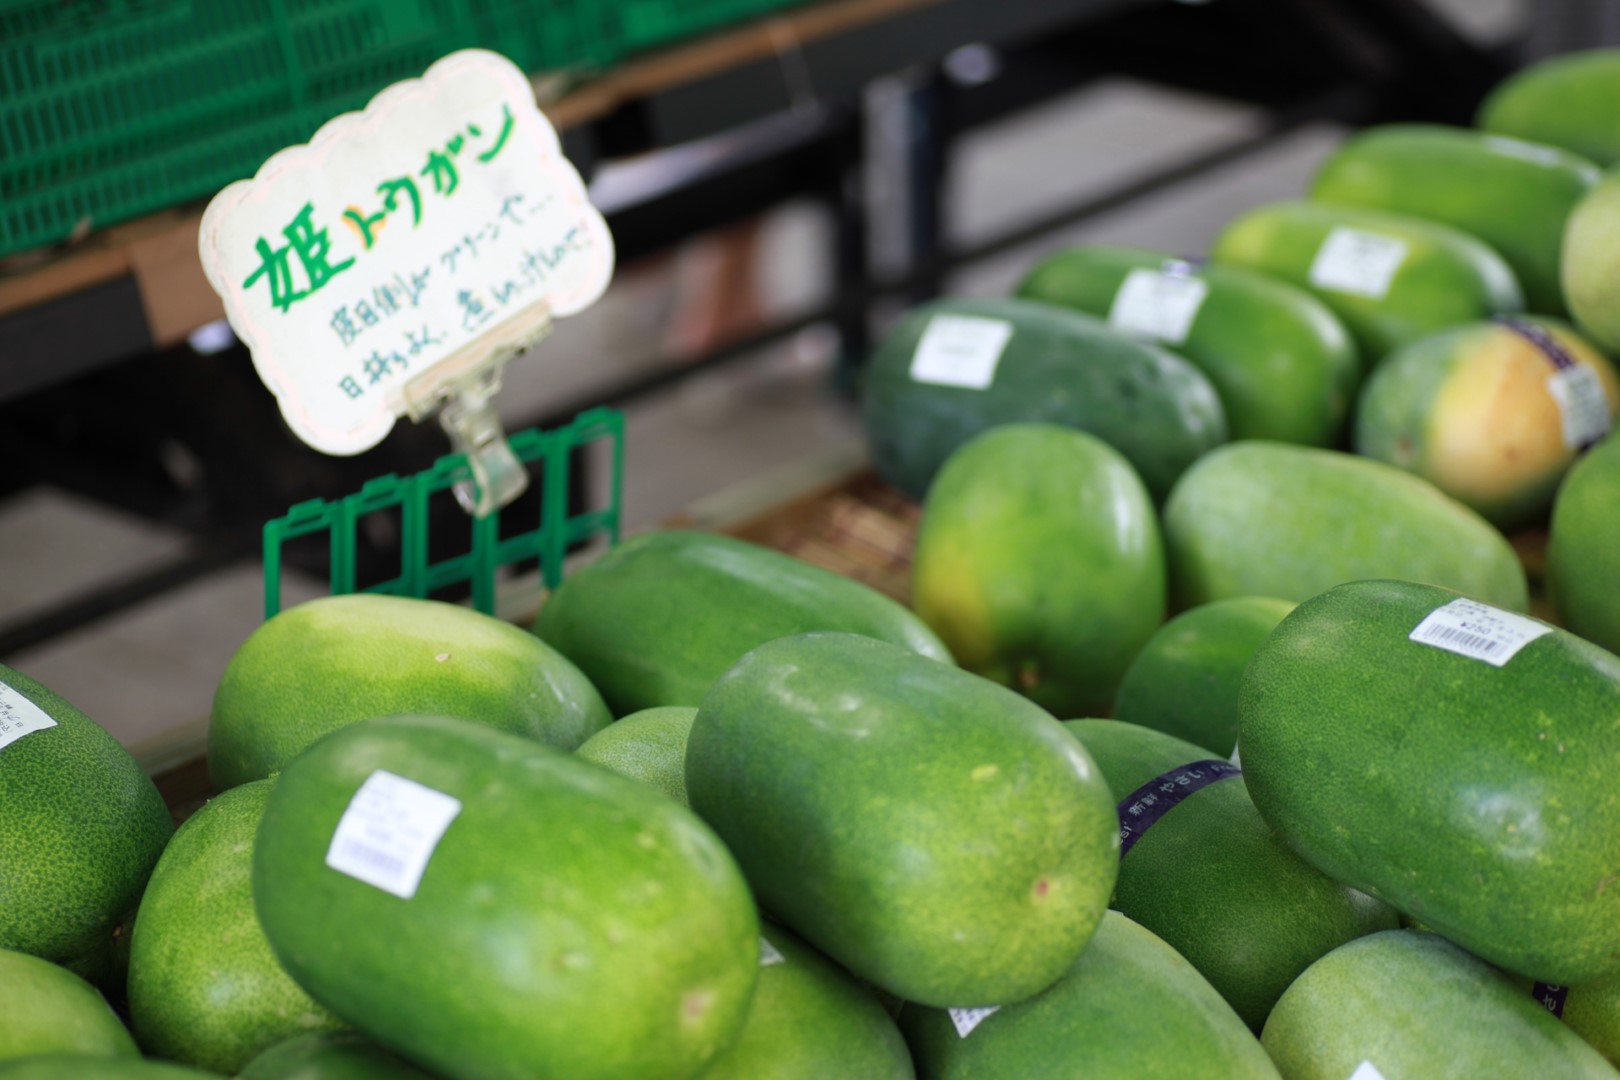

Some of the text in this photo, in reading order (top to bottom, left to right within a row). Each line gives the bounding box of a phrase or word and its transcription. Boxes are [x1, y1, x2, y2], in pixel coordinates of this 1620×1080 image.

[243, 103, 515, 314] 姫トウガン
[1128, 770, 1205, 816] 新鮮 やさい
